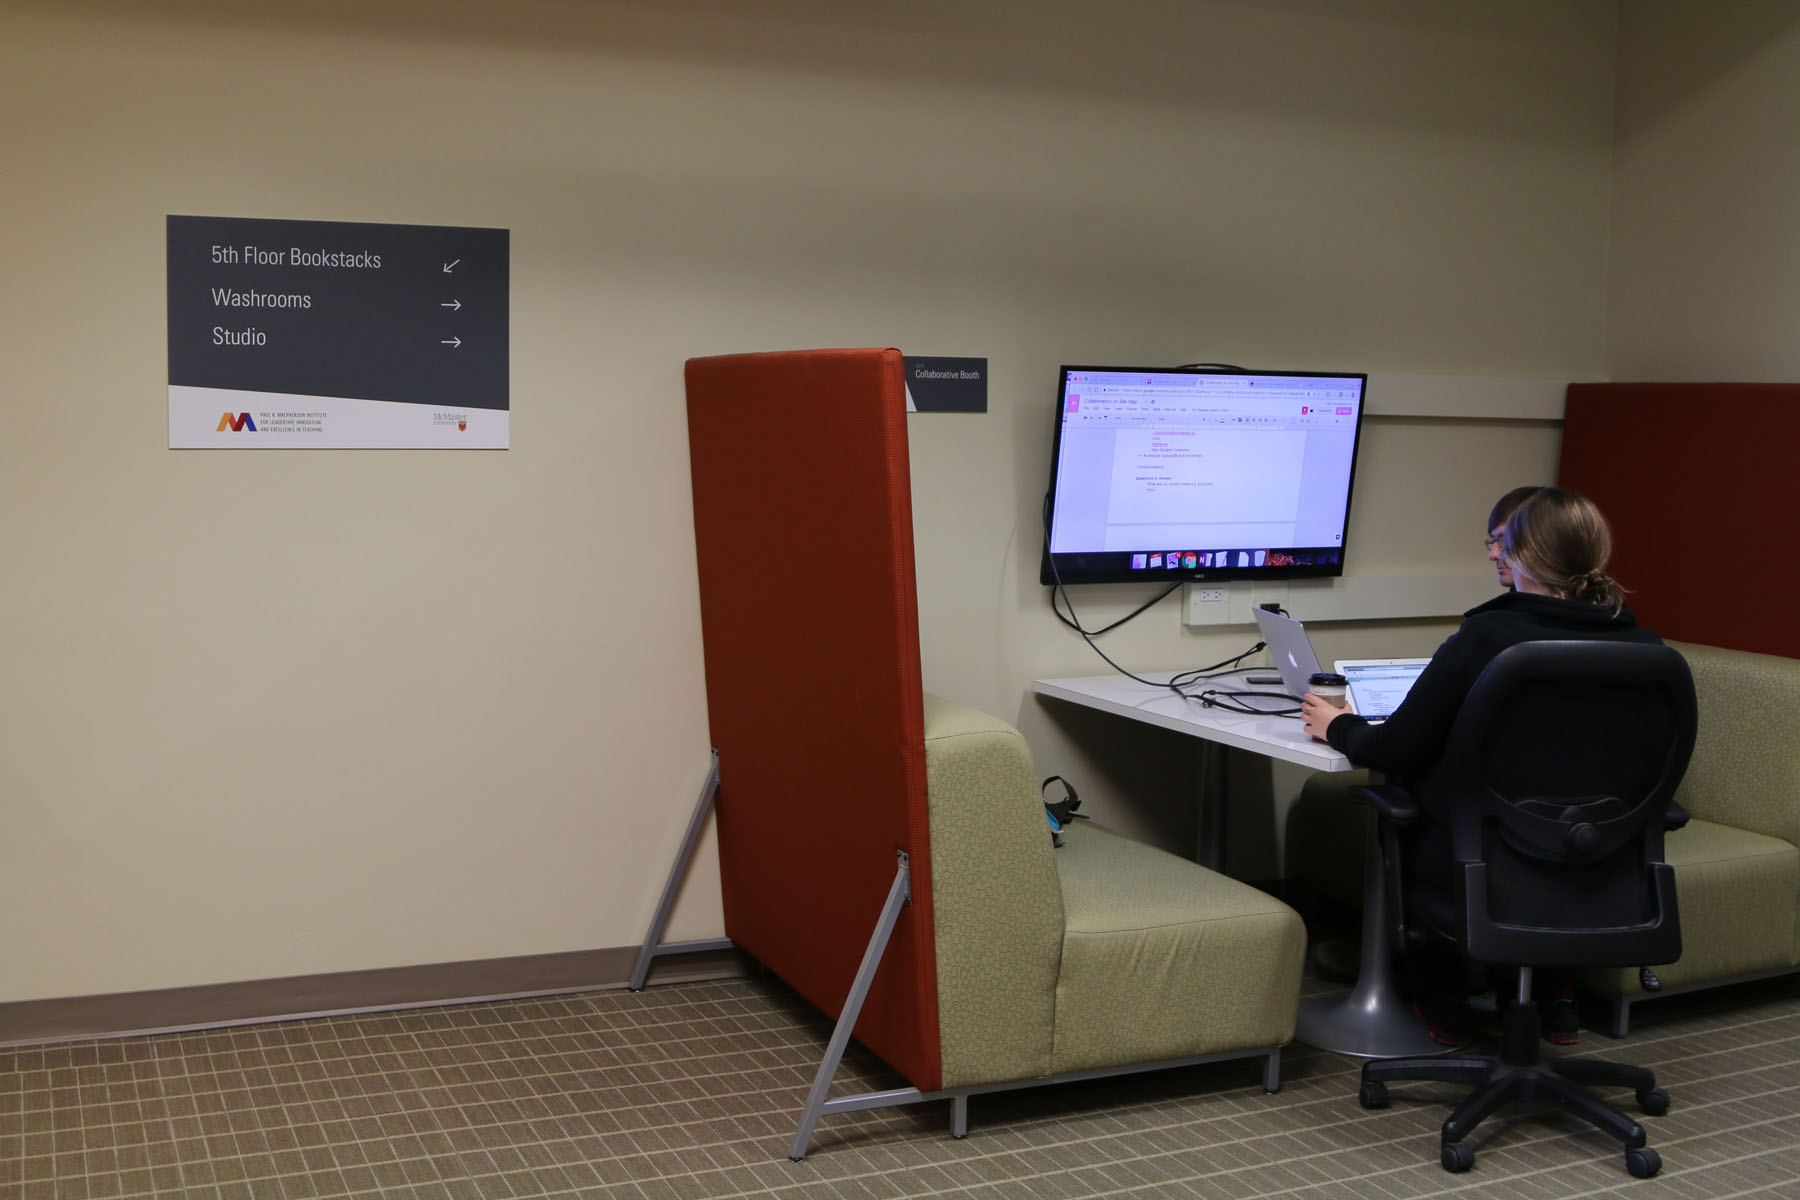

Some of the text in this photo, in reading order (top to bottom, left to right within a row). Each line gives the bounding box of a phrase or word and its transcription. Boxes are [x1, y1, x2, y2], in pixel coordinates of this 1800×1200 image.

[212, 245, 382, 269] 5th Floor Bookstacks
[211, 287, 312, 309] Washrooms
[212, 326, 267, 346] Studio
[915, 369, 980, 380] Collaborative Booth
